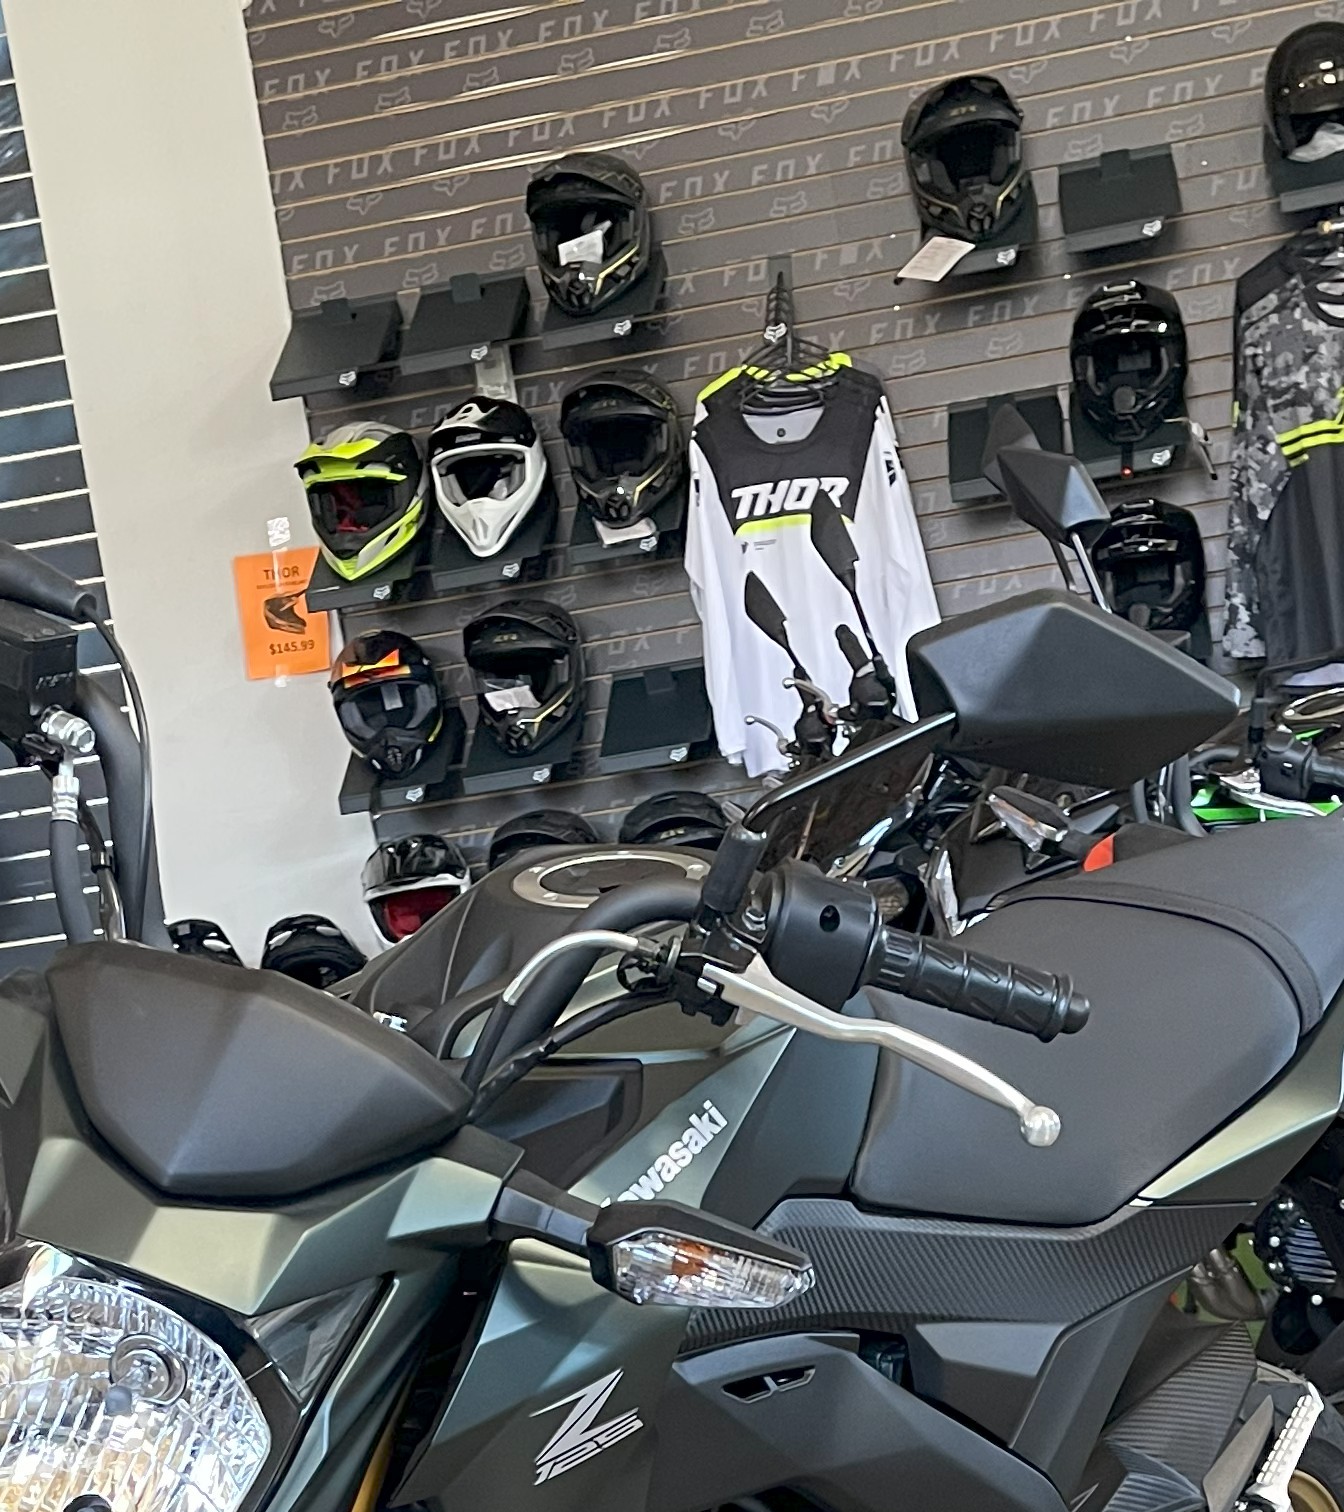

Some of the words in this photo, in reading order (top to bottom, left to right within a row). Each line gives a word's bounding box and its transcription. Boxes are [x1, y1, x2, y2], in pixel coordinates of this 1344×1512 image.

[263, 68, 331, 99] FOX
[356, 49, 424, 81] FOX
[443, 28, 513, 61] FOX
[539, 9, 609, 43] FOX
[328, 151, 394, 185] FOX
[415, 134, 482, 166] FOX
[509, 116, 575, 148] FOX
[603, 98, 672, 128] FOX
[699, 77, 768, 110] FOX
[890, 41, 960, 73] FOX
[989, 18, 1060, 53] FOX
[1090, 0, 1163, 32] FOX
[292, 244, 357, 274] FOX
[383, 227, 452, 257] FOX
[659, 171, 729, 203] FOX
[751, 152, 824, 186] FOX
[848, 139, 894, 167] FO
[1047, 94, 1121, 128] FOX
[1147, 74, 1223, 108] FOX
[723, 260, 767, 286] FO
[1211, 166, 1258, 196] FO
[522, 382, 564, 406] OX
[870, 312, 941, 344] FOX
[968, 296, 1039, 330] FOX
[1165, 257, 1241, 290] FOX
[731, 476, 850, 520] THOR
[269, 640, 315, 656] $145.99
[600, 1099, 728, 1208] wasaki
[528, 1366, 639, 1467] Z
[534, 1414, 645, 1486] 125
